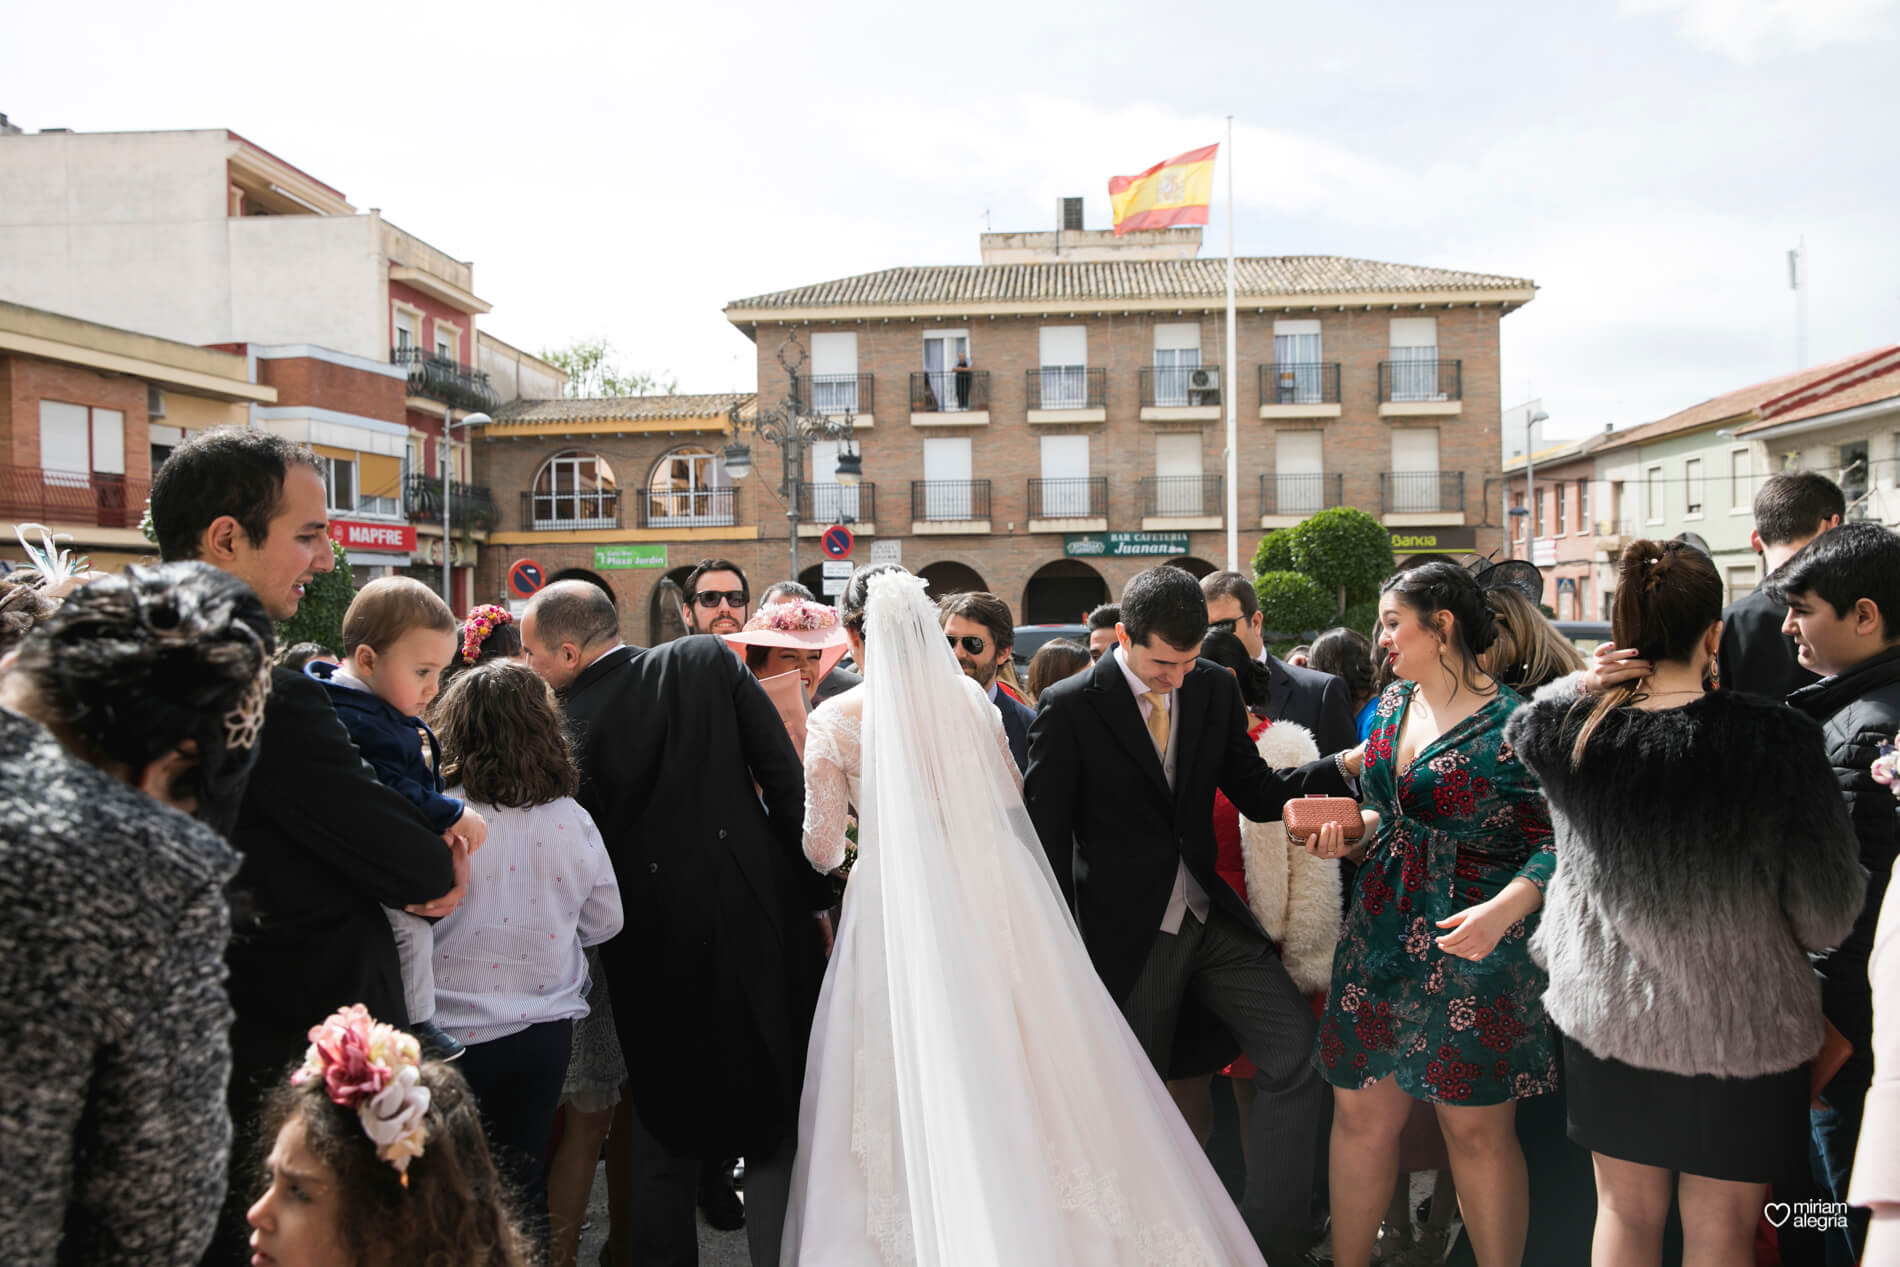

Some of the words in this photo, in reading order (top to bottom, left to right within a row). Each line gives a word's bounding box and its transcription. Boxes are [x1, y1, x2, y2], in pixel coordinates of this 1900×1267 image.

[349, 526, 403, 546] MAPFRE
[1111, 533, 1131, 542] BAR
[1391, 534, 1437, 547] Bankia
[1113, 542, 1168, 554] Juanan
